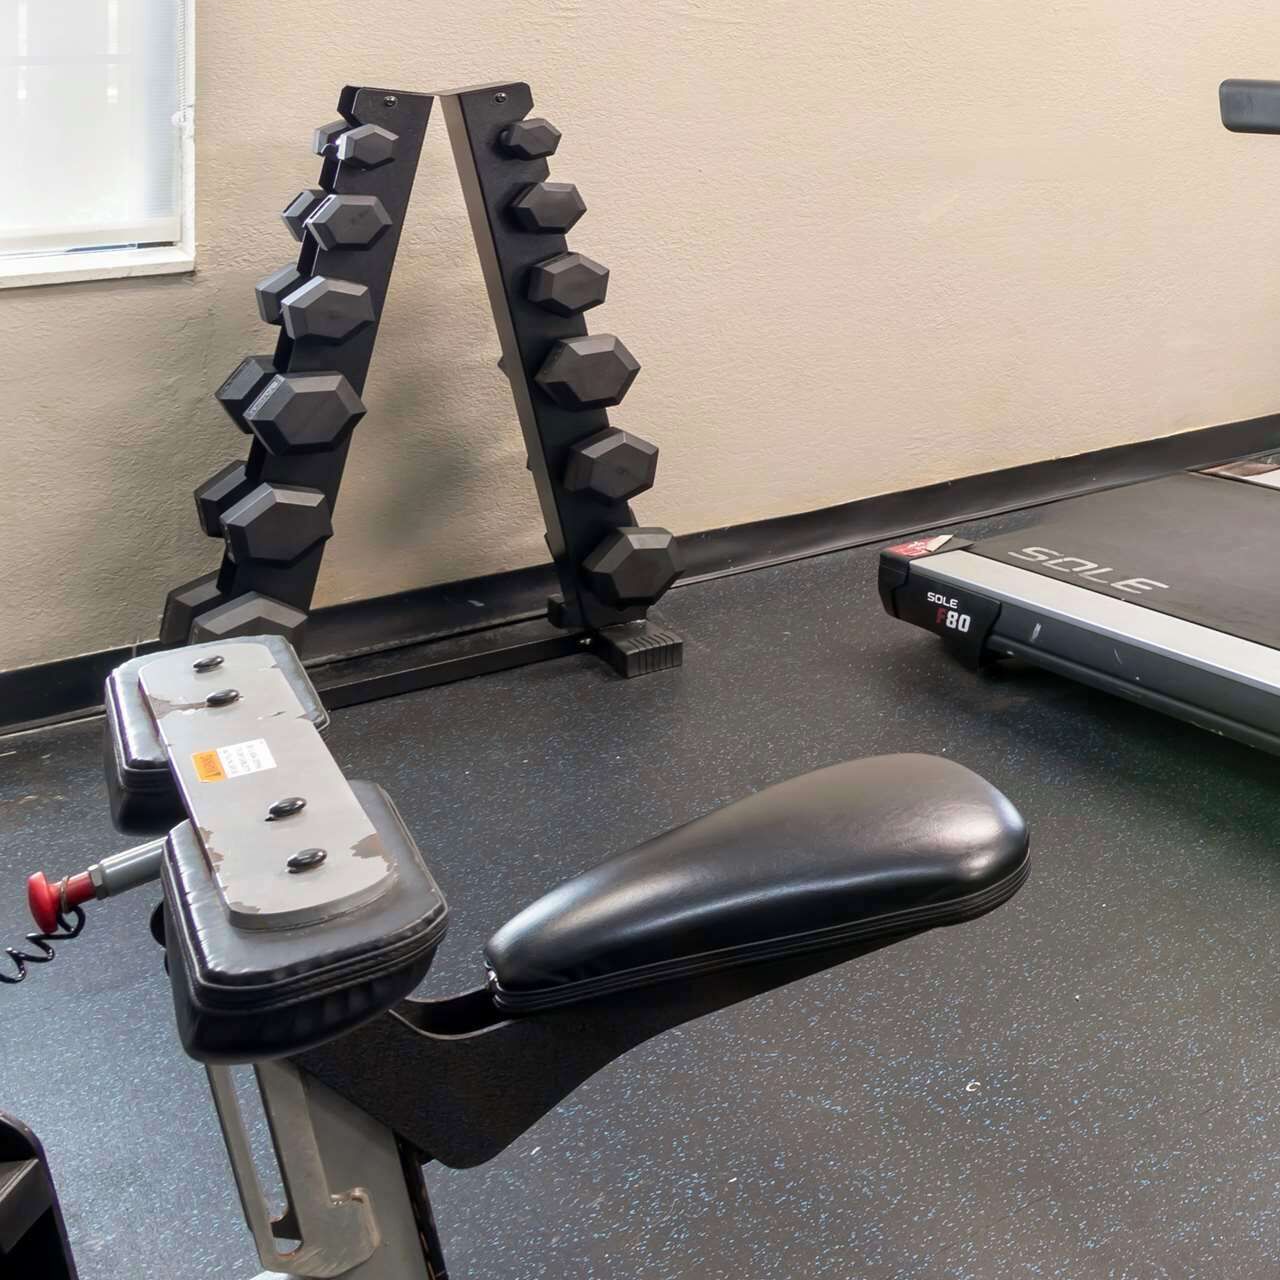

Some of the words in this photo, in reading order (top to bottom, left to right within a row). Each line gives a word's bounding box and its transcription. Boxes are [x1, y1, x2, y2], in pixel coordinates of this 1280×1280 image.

[1007, 546, 1170, 595] SOLE
[927, 591, 959, 609] SOLE
[935, 607, 971, 632] F80
